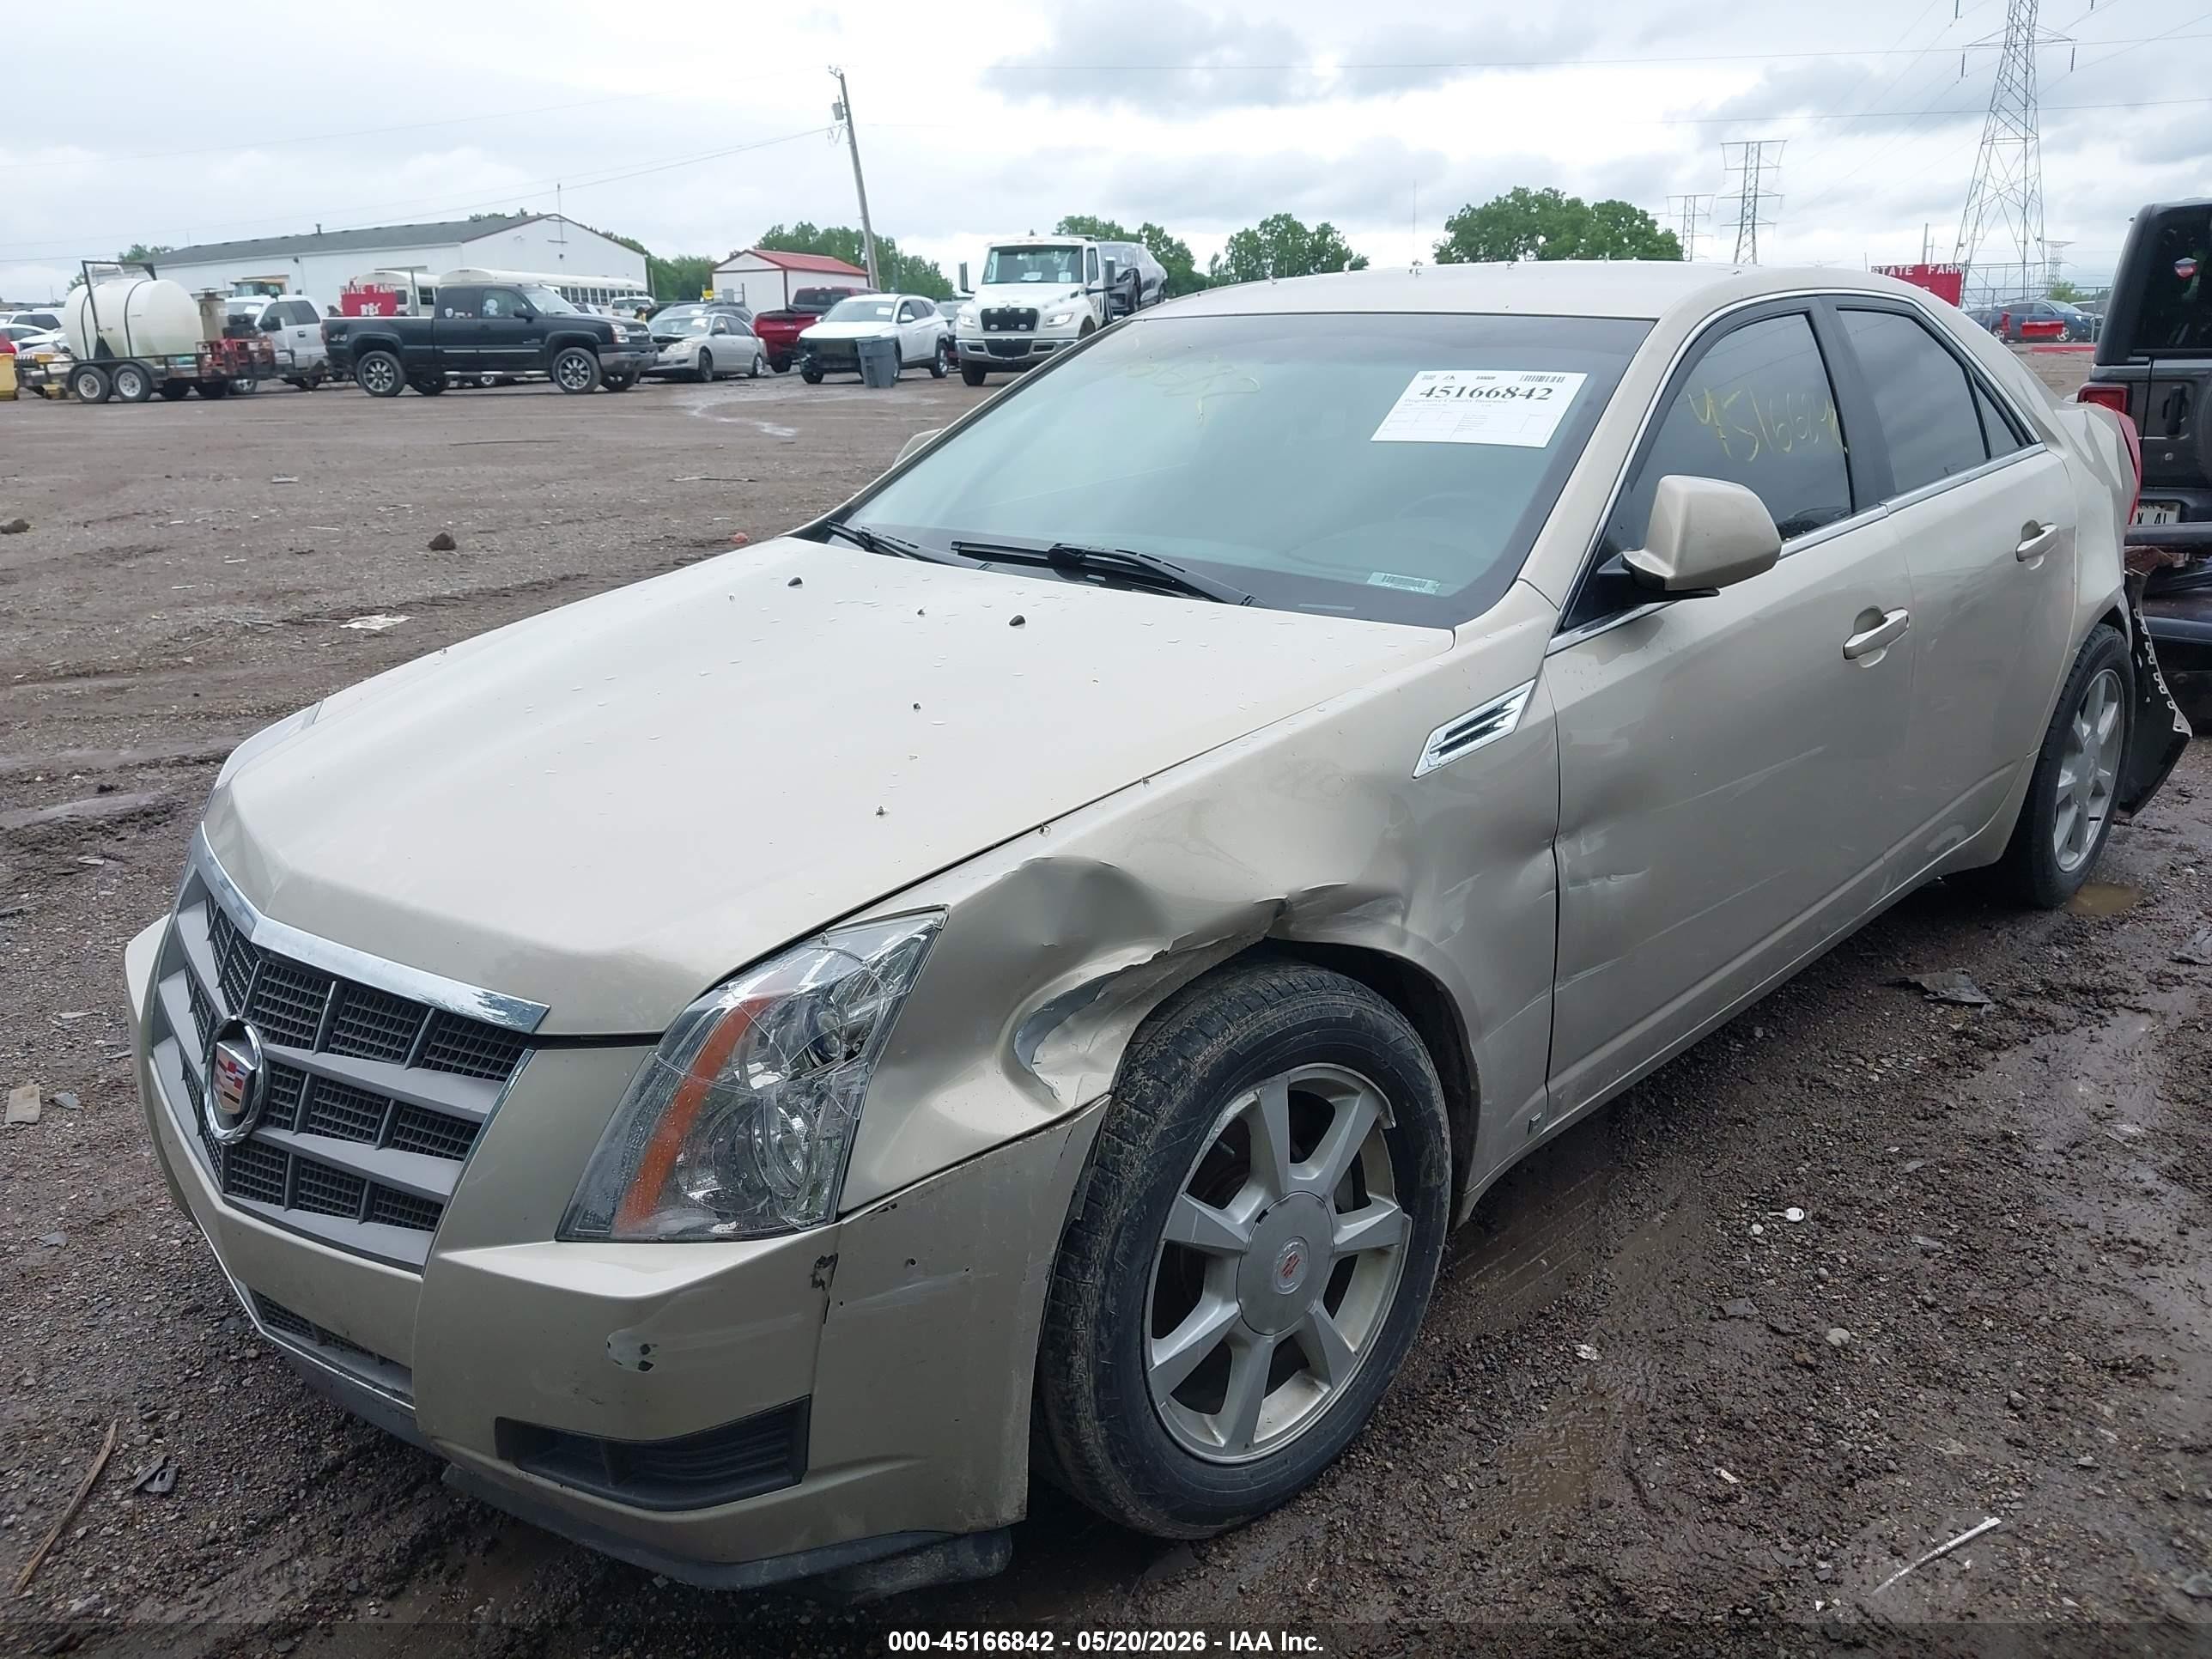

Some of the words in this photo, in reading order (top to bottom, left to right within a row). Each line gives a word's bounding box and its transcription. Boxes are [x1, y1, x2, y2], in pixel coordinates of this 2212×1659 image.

[1872, 266, 1914, 276] STATE
[1928, 264, 1963, 275] FARM
[1419, 386, 1553, 400] 45166842
